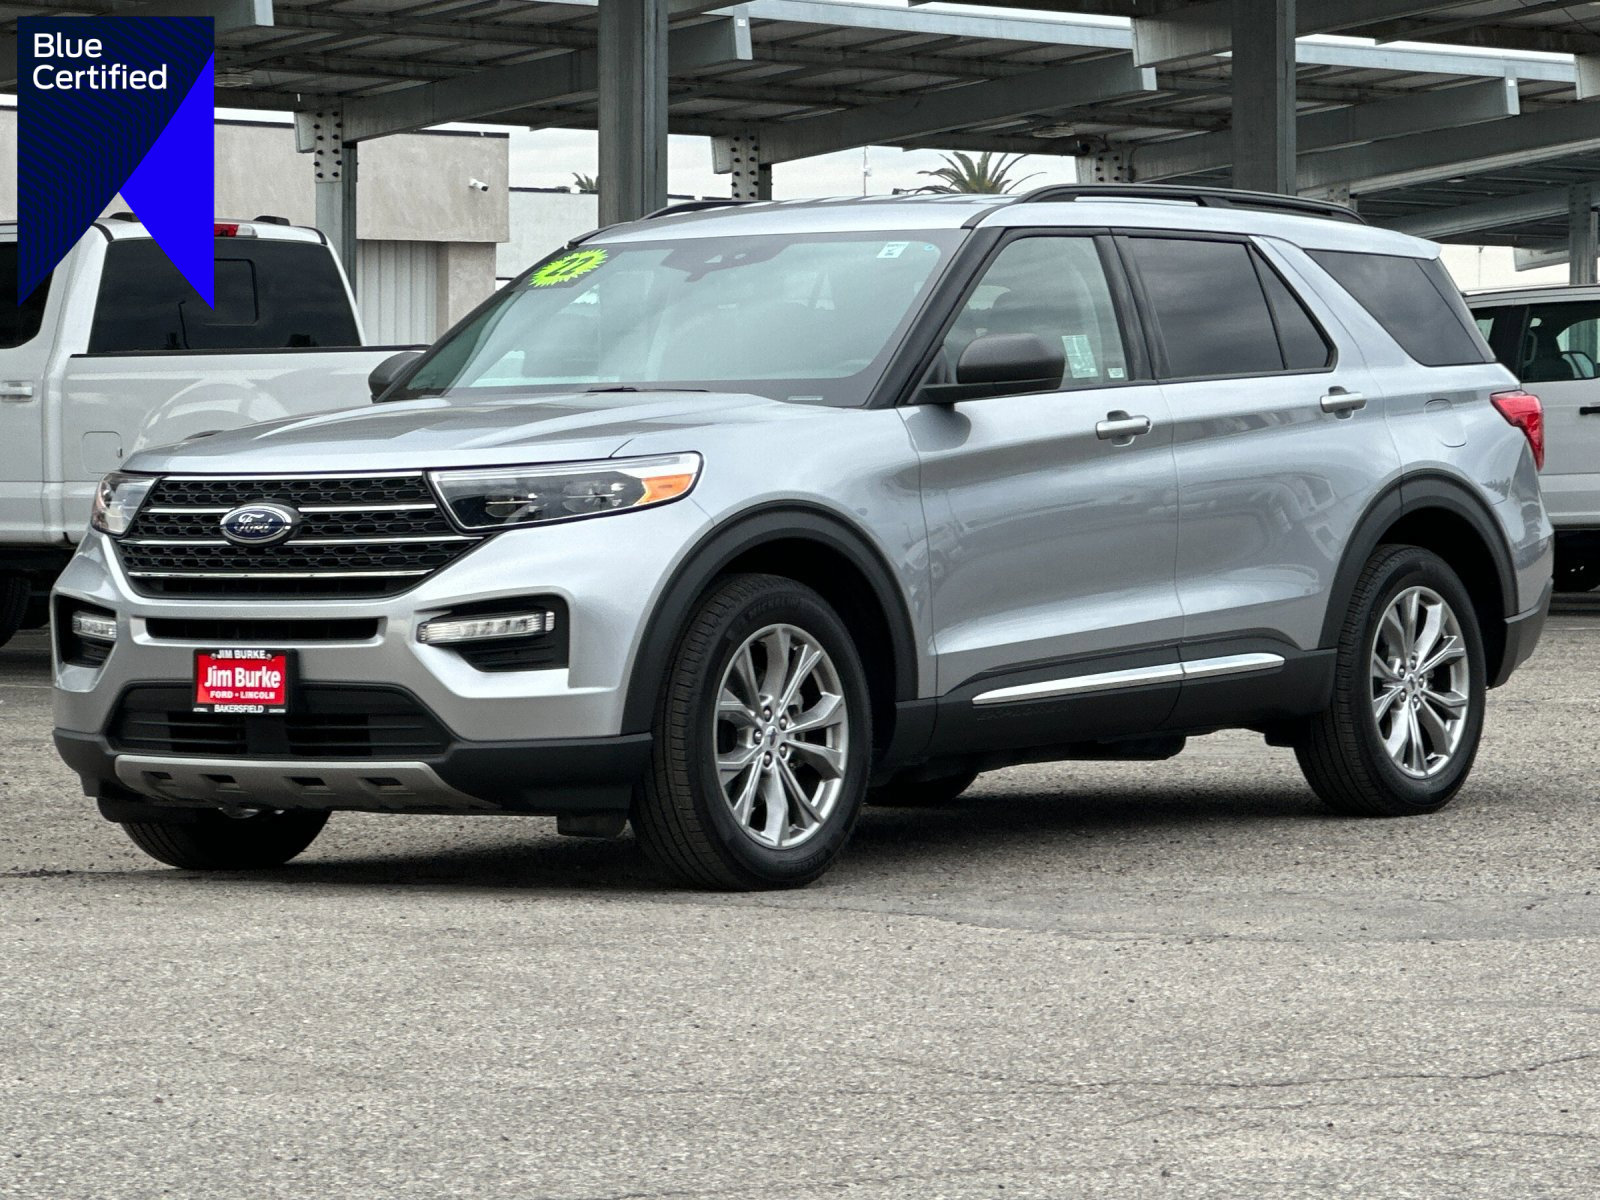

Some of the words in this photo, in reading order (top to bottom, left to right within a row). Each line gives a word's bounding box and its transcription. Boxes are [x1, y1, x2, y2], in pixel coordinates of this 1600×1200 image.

[544, 255, 596, 277] 22
[233, 512, 273, 533] Ford
[217, 649, 233, 659] JIM
[234, 649, 266, 660] BURKE
[204, 665, 232, 687] Jim
[235, 666, 281, 688] Burke
[214, 704, 264, 713] BAKERSFIELD
